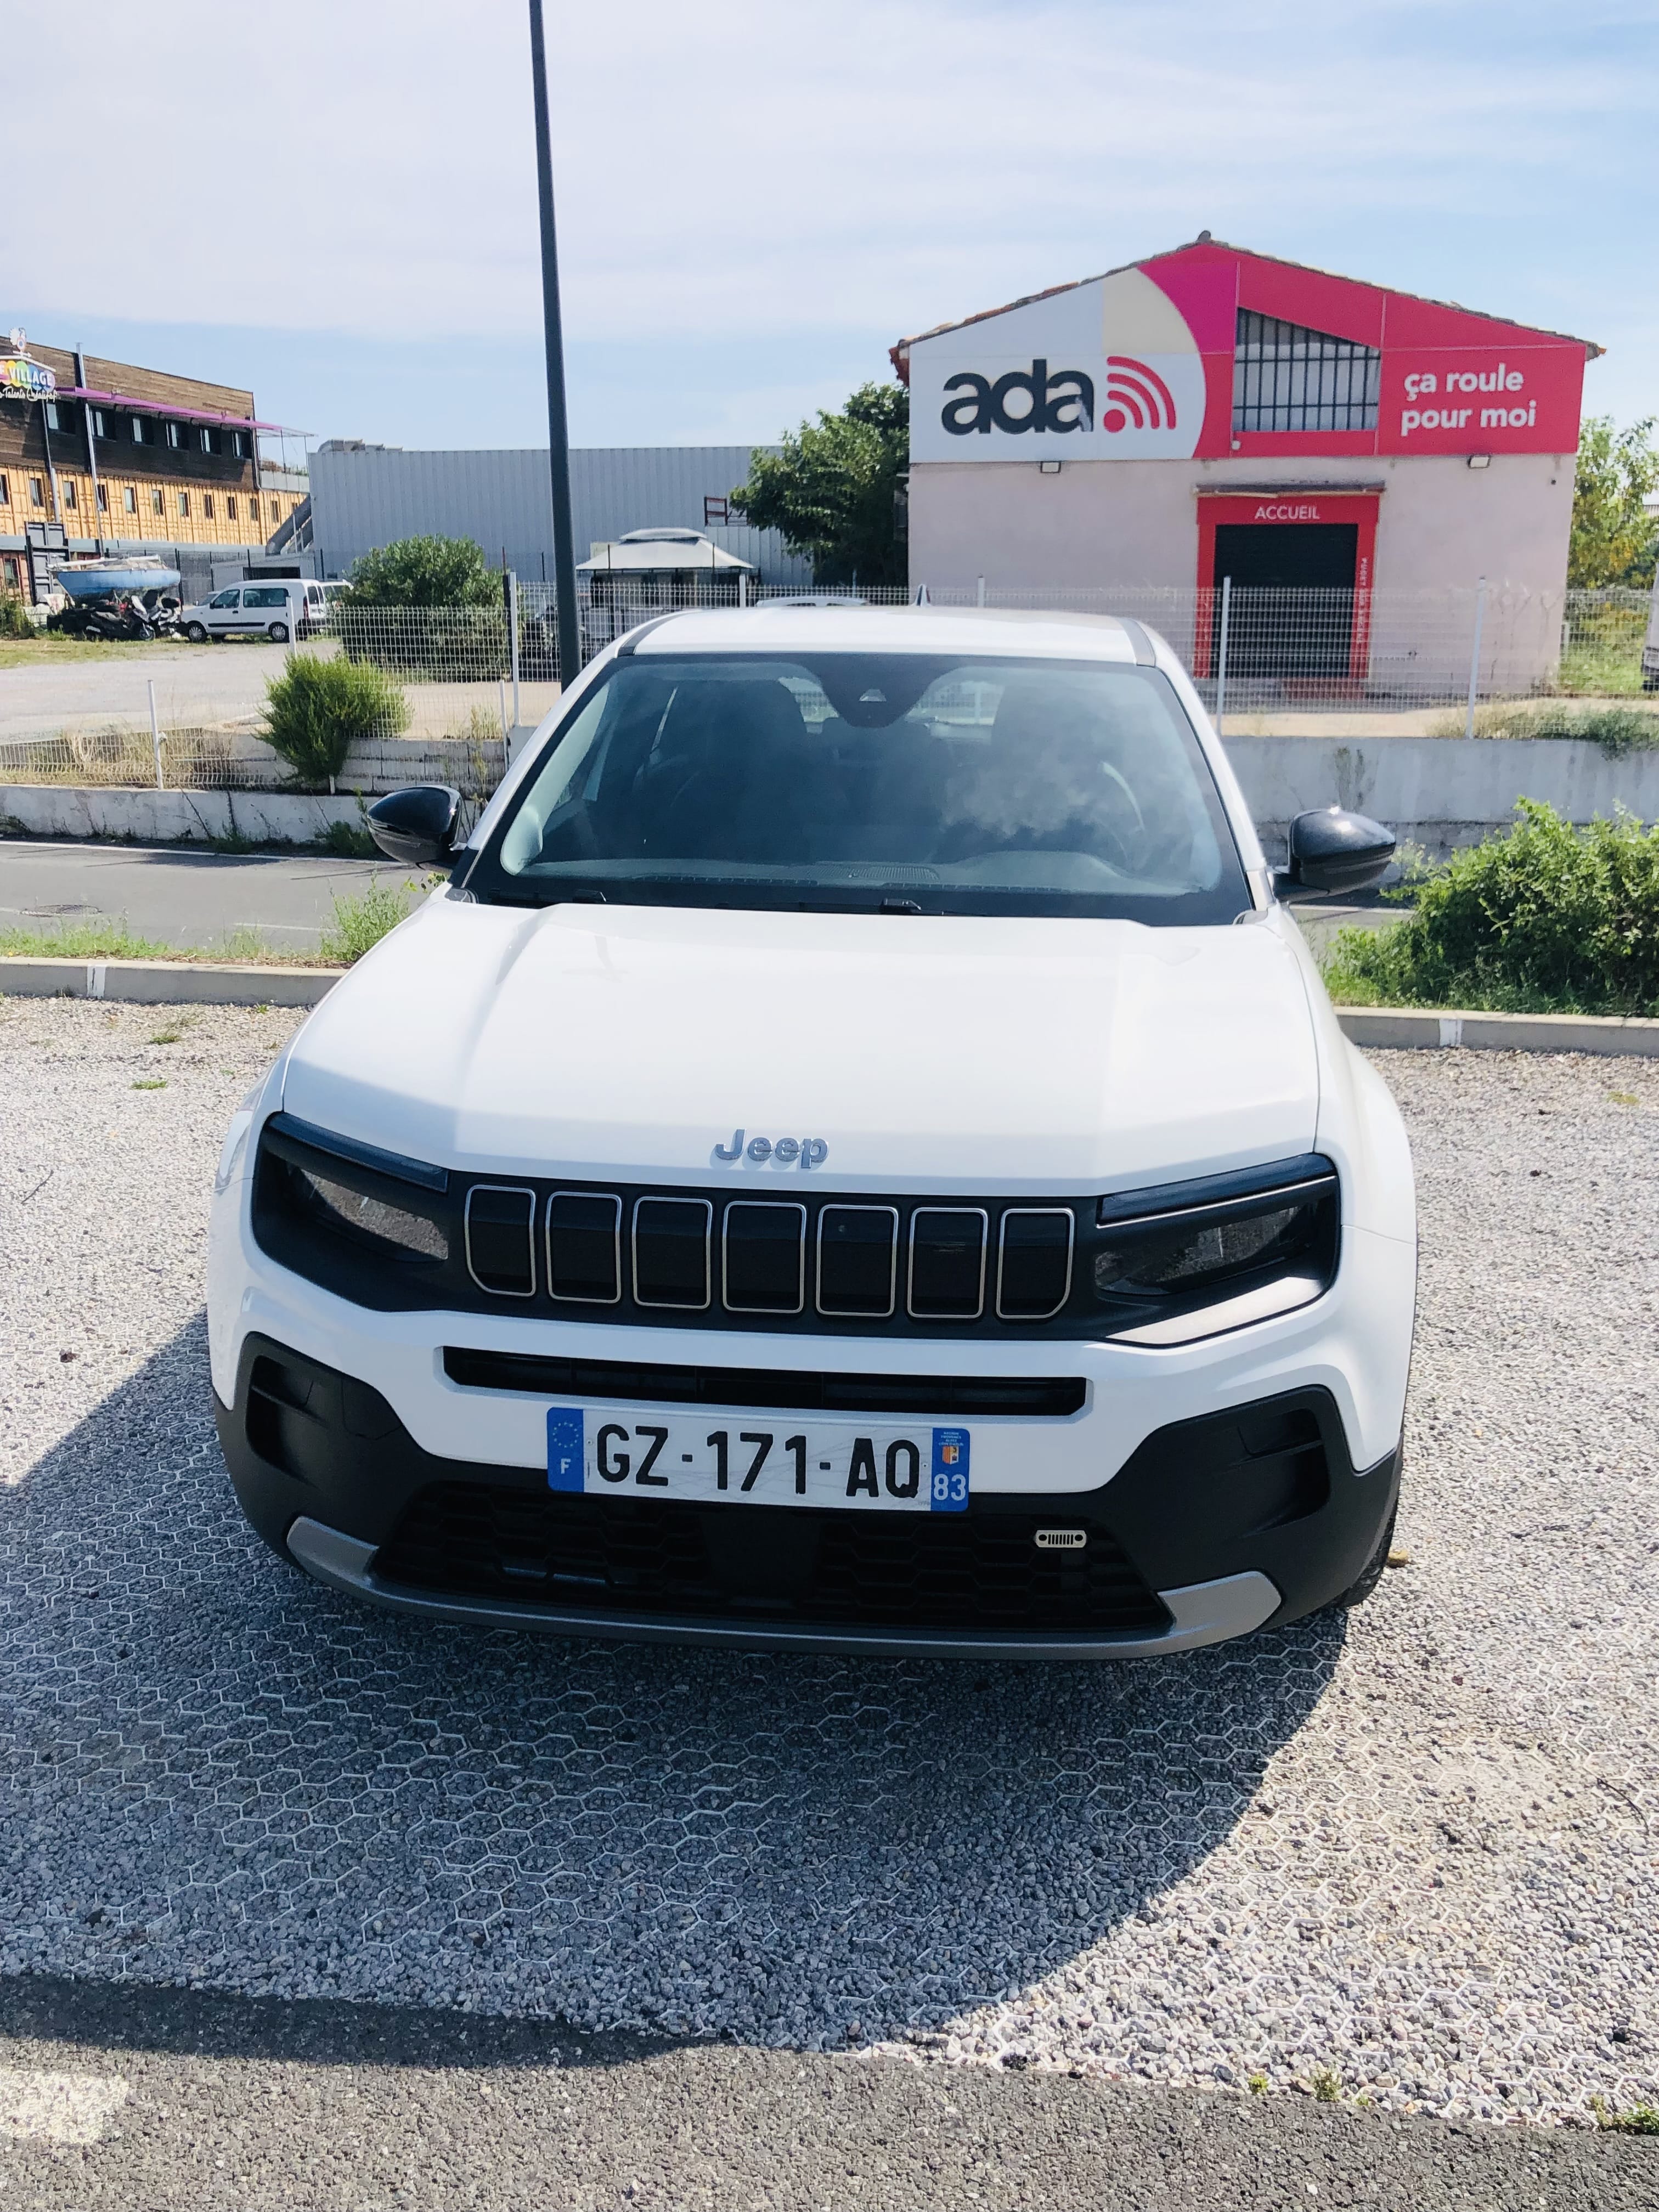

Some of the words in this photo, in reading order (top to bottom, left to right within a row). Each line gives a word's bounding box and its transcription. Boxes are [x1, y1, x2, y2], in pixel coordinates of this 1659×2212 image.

[9, 366, 52, 387] VILLAGE
[1404, 373, 1437, 402] ça
[1446, 363, 1524, 393] roule
[941, 359, 1094, 435] ada
[1401, 409, 1473, 437] pour
[1480, 399, 1537, 427] moi
[1255, 505, 1321, 520] ACCUEIL
[714, 1128, 829, 1169] Jeep
[560, 1458, 572, 1475] F
[596, 1424, 920, 1499] GZ-171-AQ
[934, 1474, 966, 1501] 83
